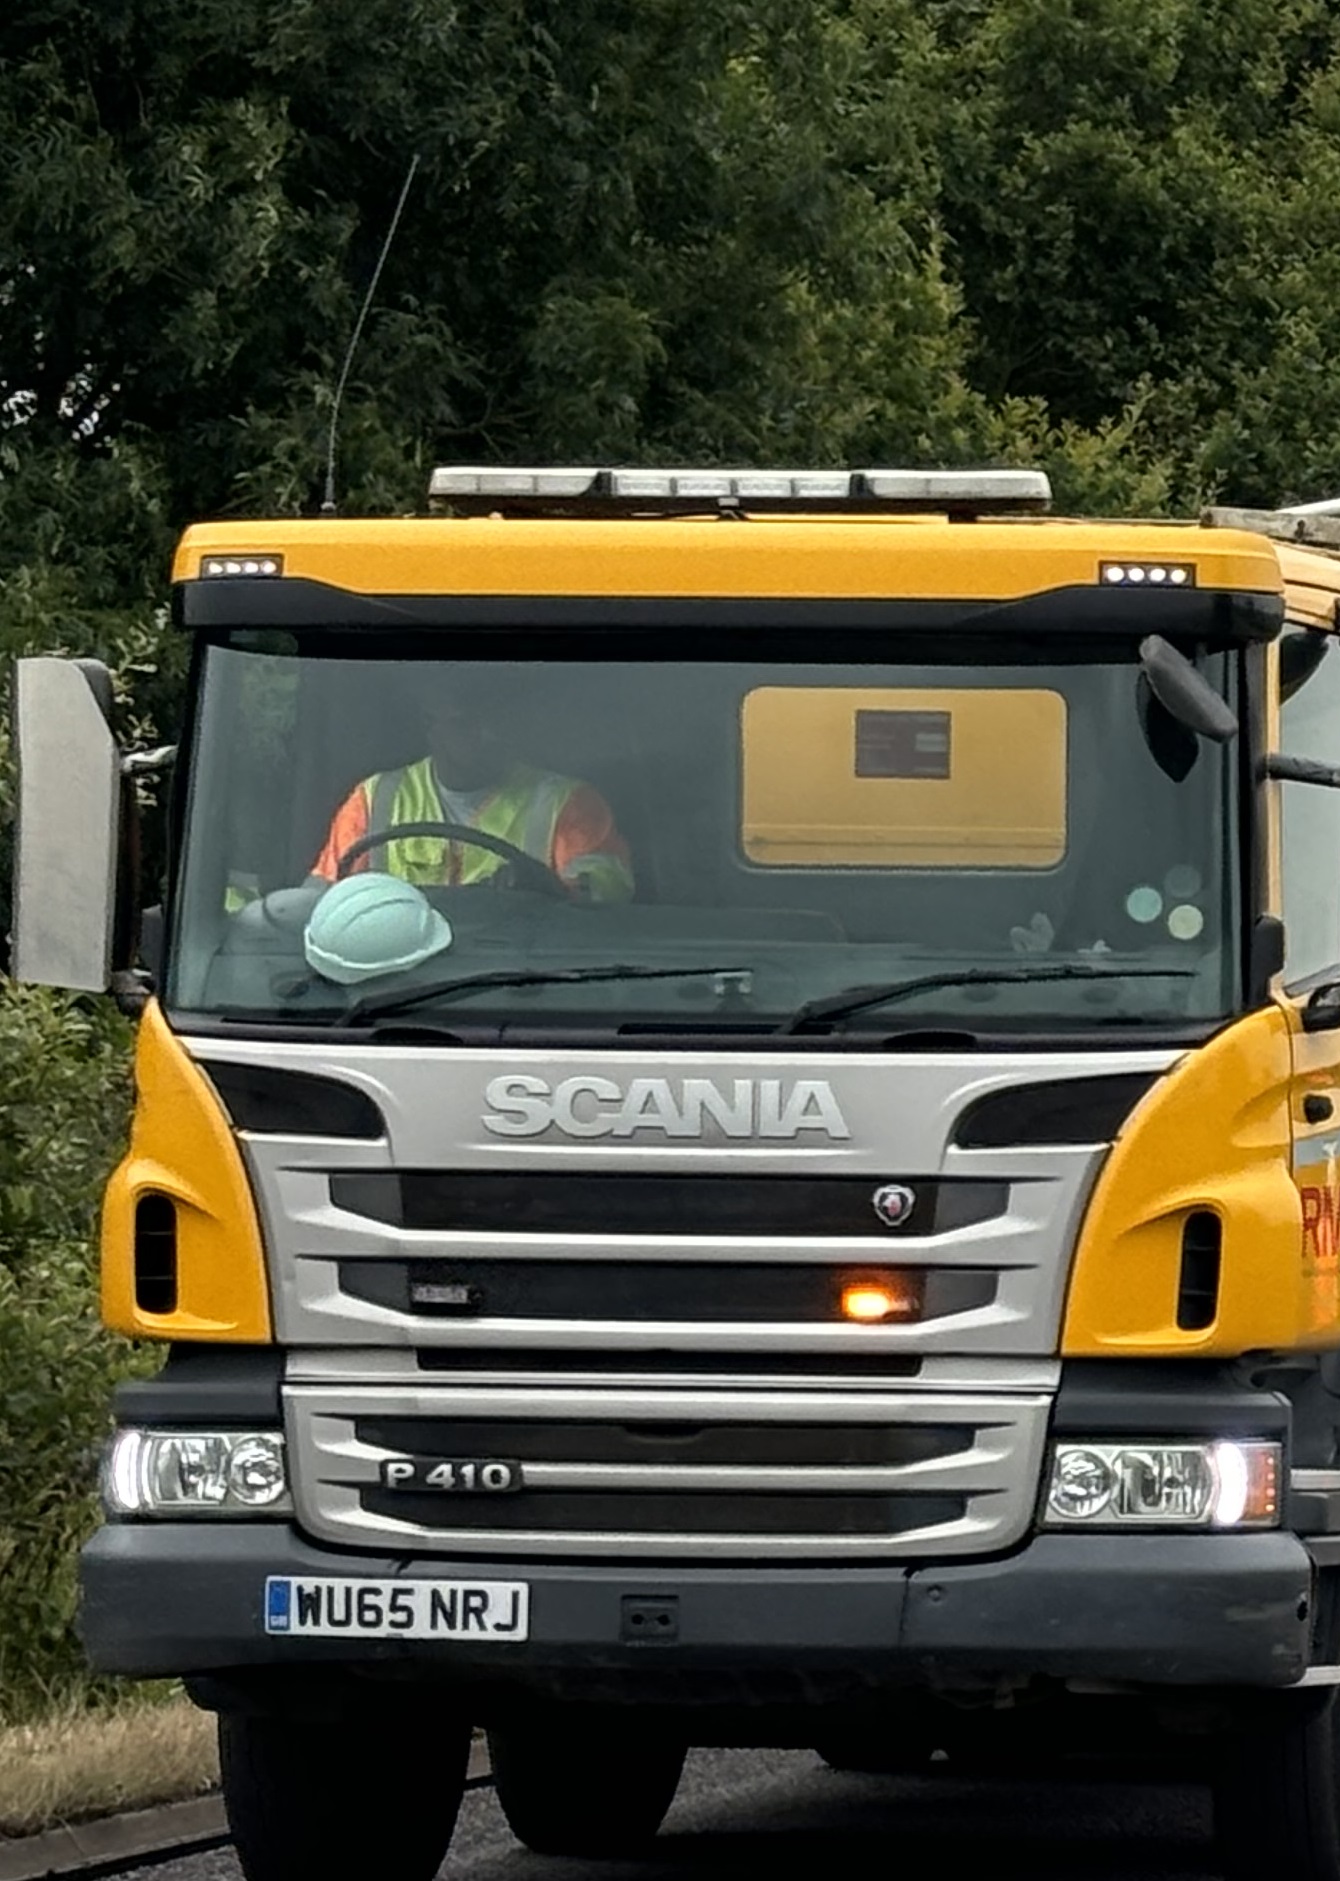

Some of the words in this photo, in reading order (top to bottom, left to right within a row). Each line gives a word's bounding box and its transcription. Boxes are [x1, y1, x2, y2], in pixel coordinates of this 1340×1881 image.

[480, 1074, 852, 1140] SCANIA
[387, 1462, 415, 1489] P
[425, 1463, 511, 1490] 410
[297, 1584, 414, 1629] WU65
[430, 1588, 519, 1631] NRJ
